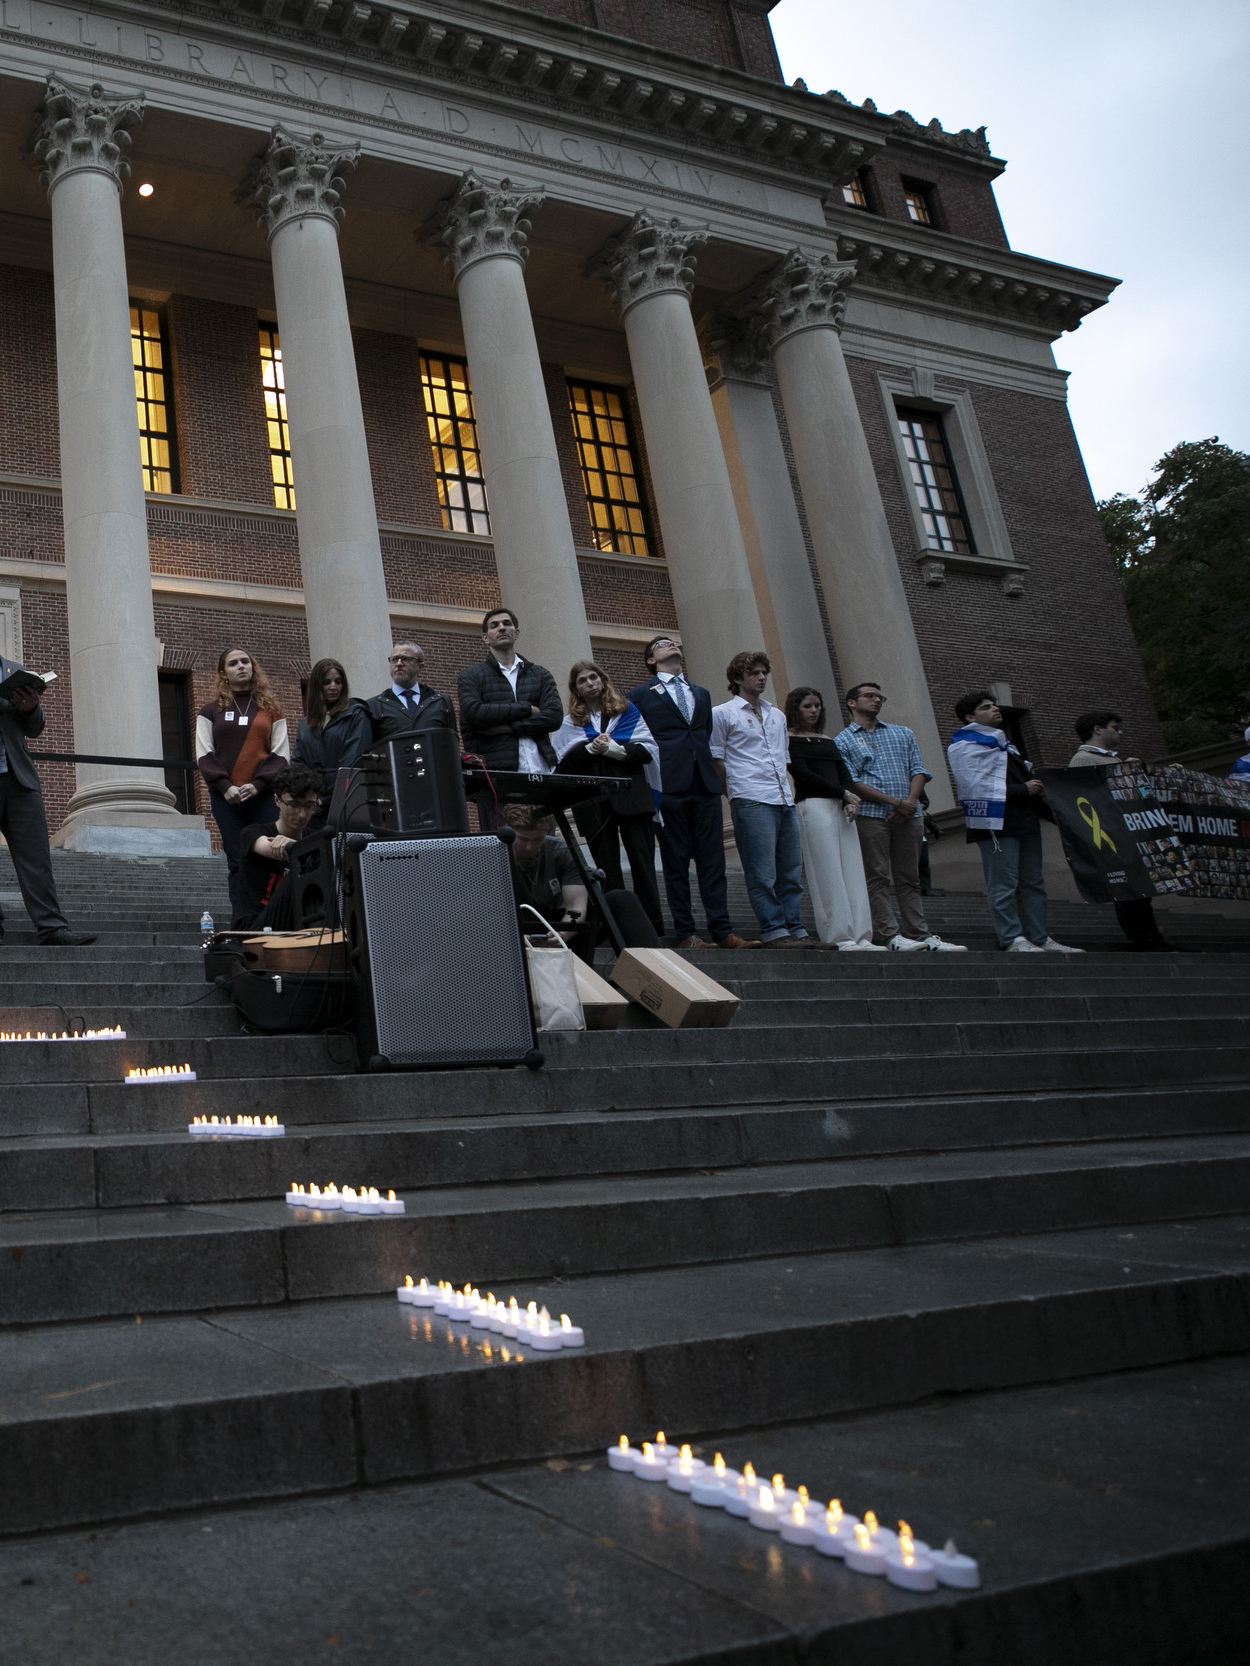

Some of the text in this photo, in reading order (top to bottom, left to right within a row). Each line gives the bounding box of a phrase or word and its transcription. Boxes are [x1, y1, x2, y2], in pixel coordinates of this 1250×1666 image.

[78, 16, 330, 101] LIBRARY
[380, 92, 404, 120] A
[445, 107, 470, 134] D
[516, 124, 713, 193] MCMXIV
[1196, 816, 1239, 837] HOME
